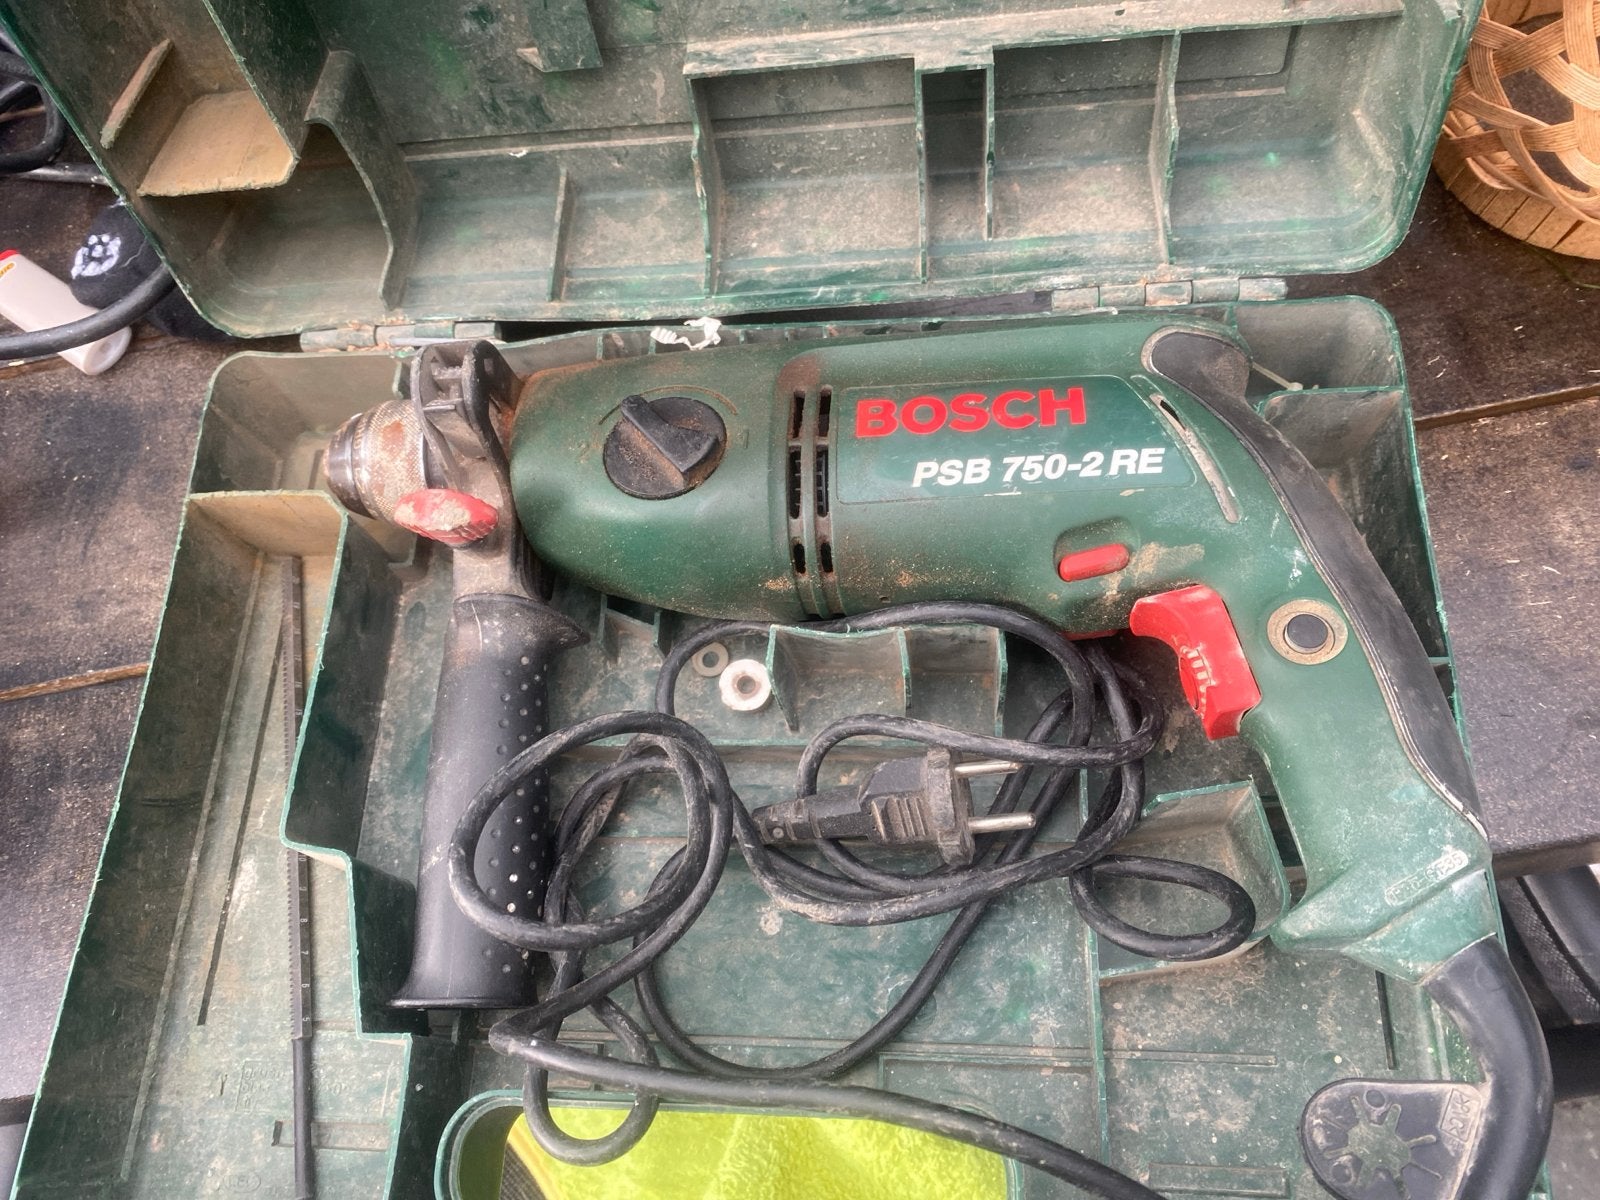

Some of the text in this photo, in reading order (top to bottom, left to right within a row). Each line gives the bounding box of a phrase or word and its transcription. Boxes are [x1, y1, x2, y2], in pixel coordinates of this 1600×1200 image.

[856, 387, 1087, 437] BOSCH
[912, 448, 1165, 487] PSB 750-2 RE
